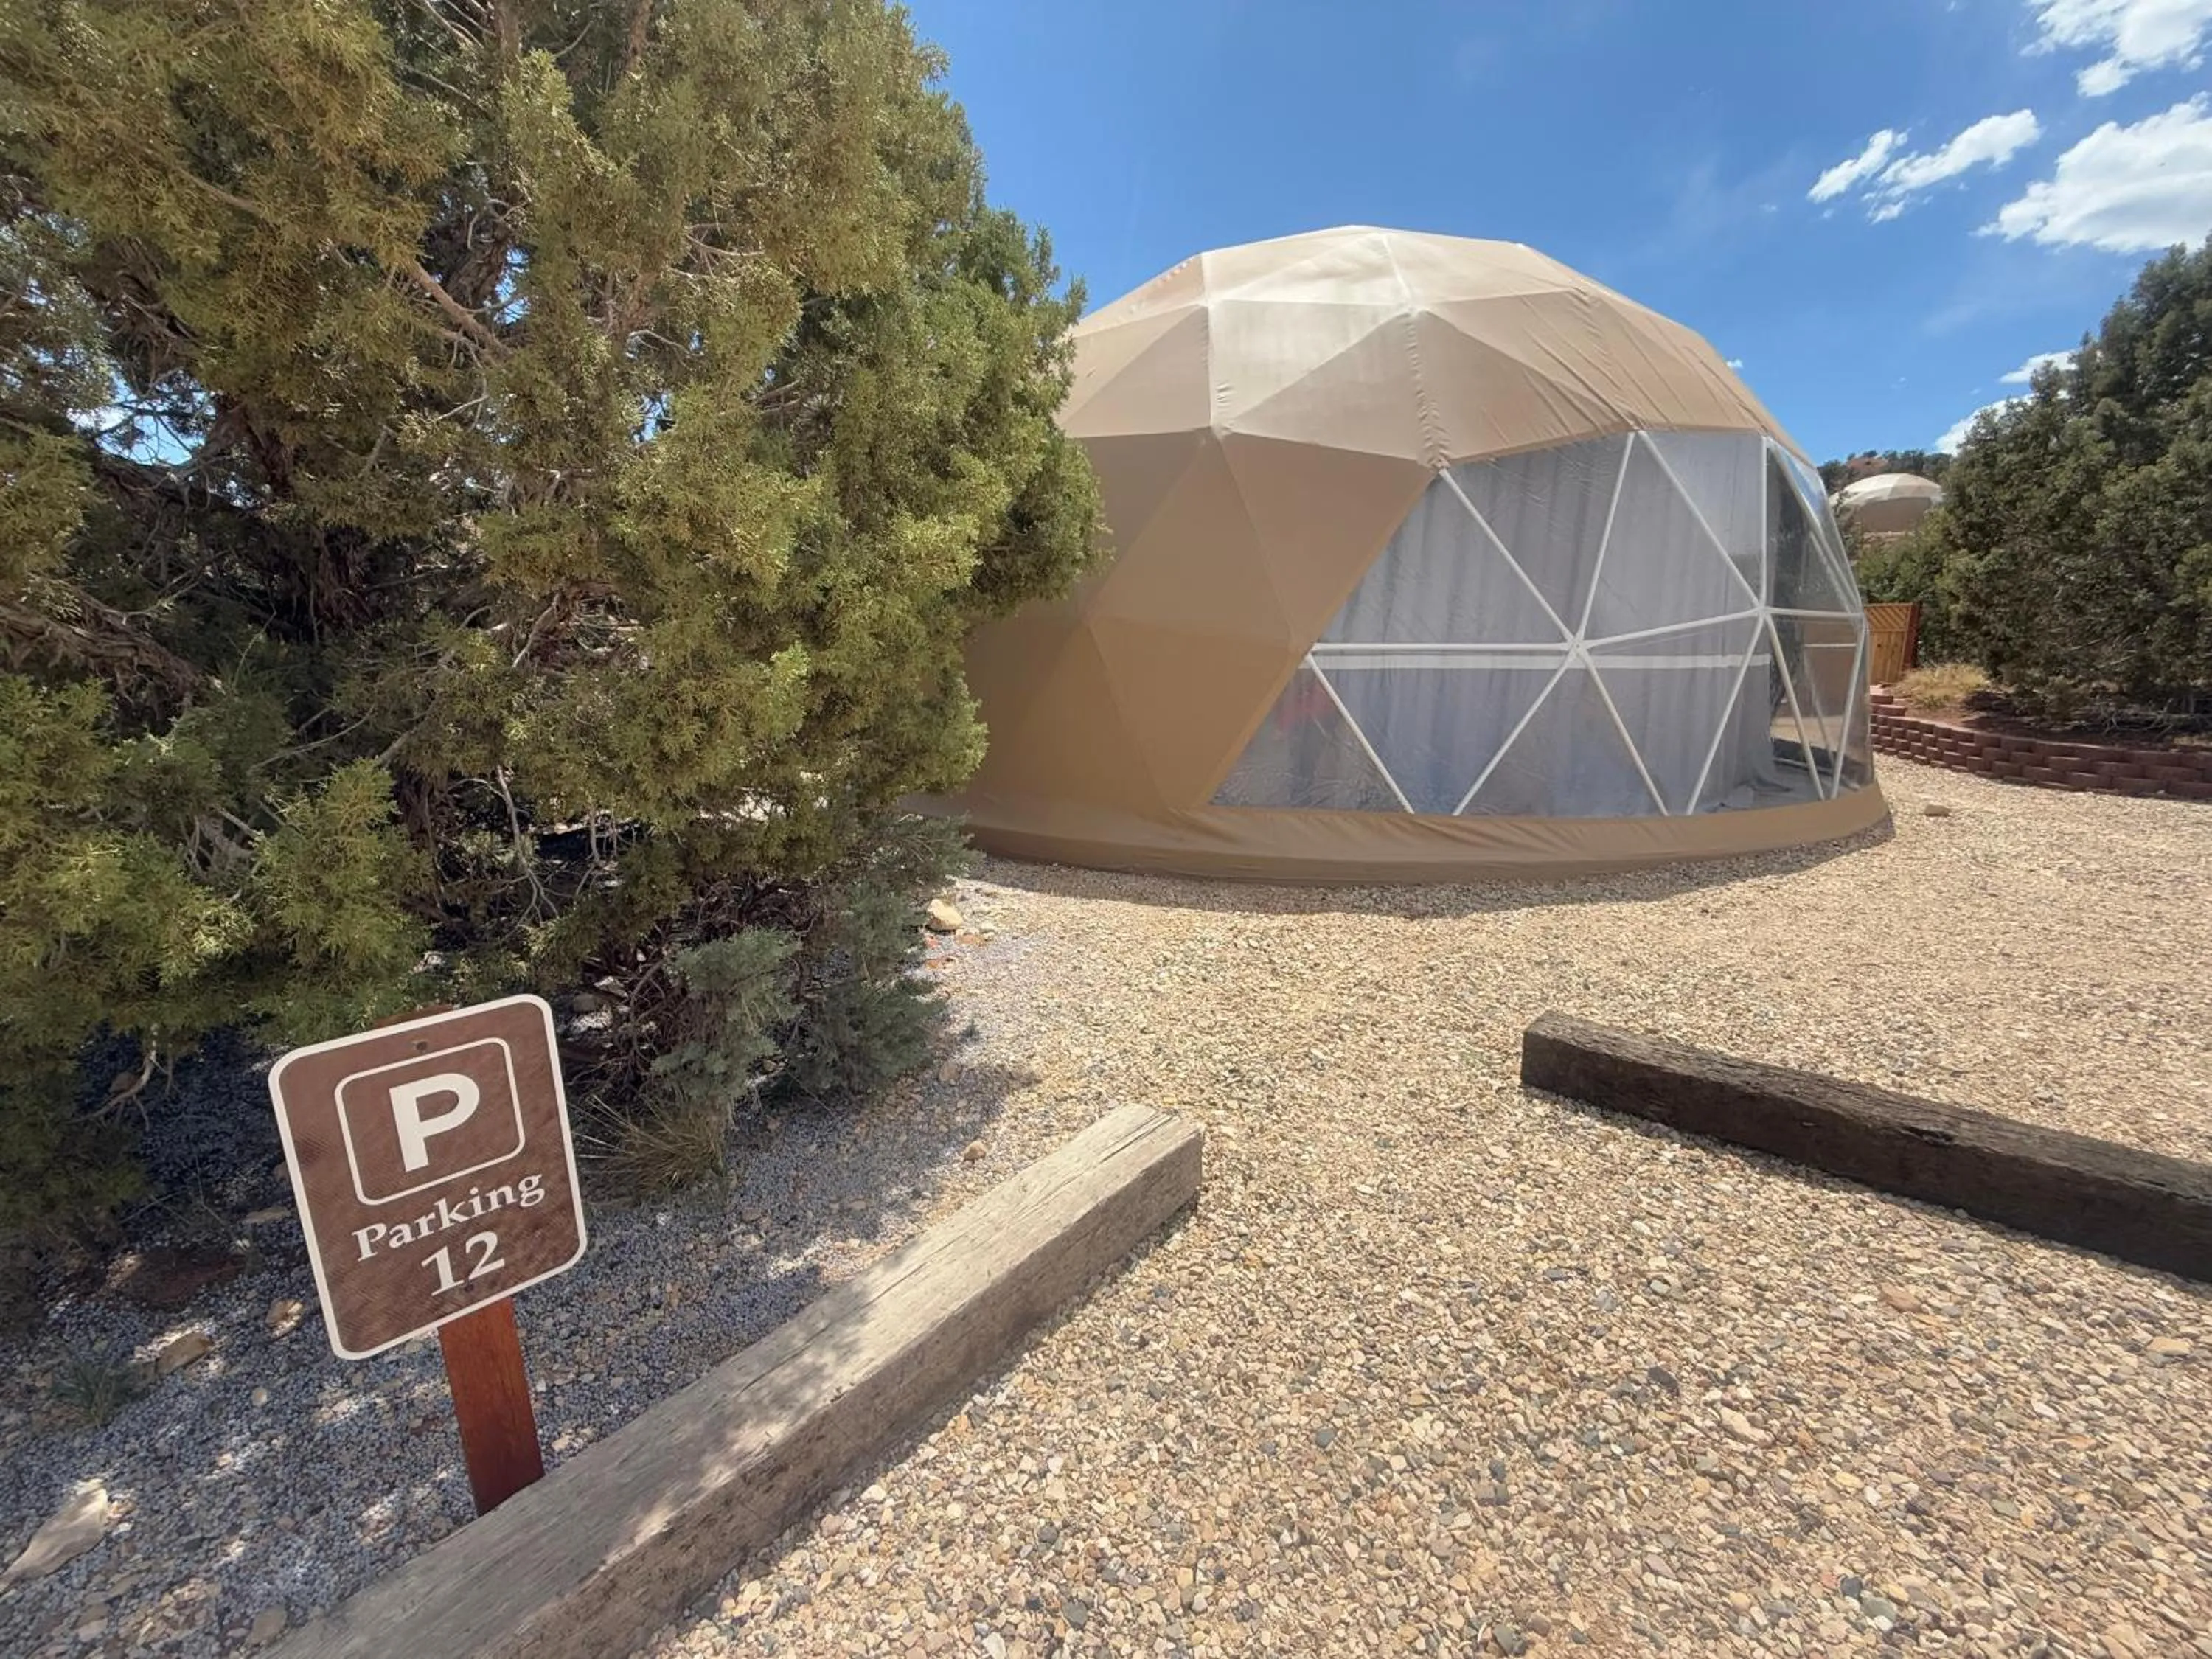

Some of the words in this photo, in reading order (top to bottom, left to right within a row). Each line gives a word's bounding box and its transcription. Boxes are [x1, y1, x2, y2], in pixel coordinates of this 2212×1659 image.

[389, 1073, 480, 1172] P
[352, 1173, 546, 1262] Parking
[421, 1231, 506, 1296] 12
